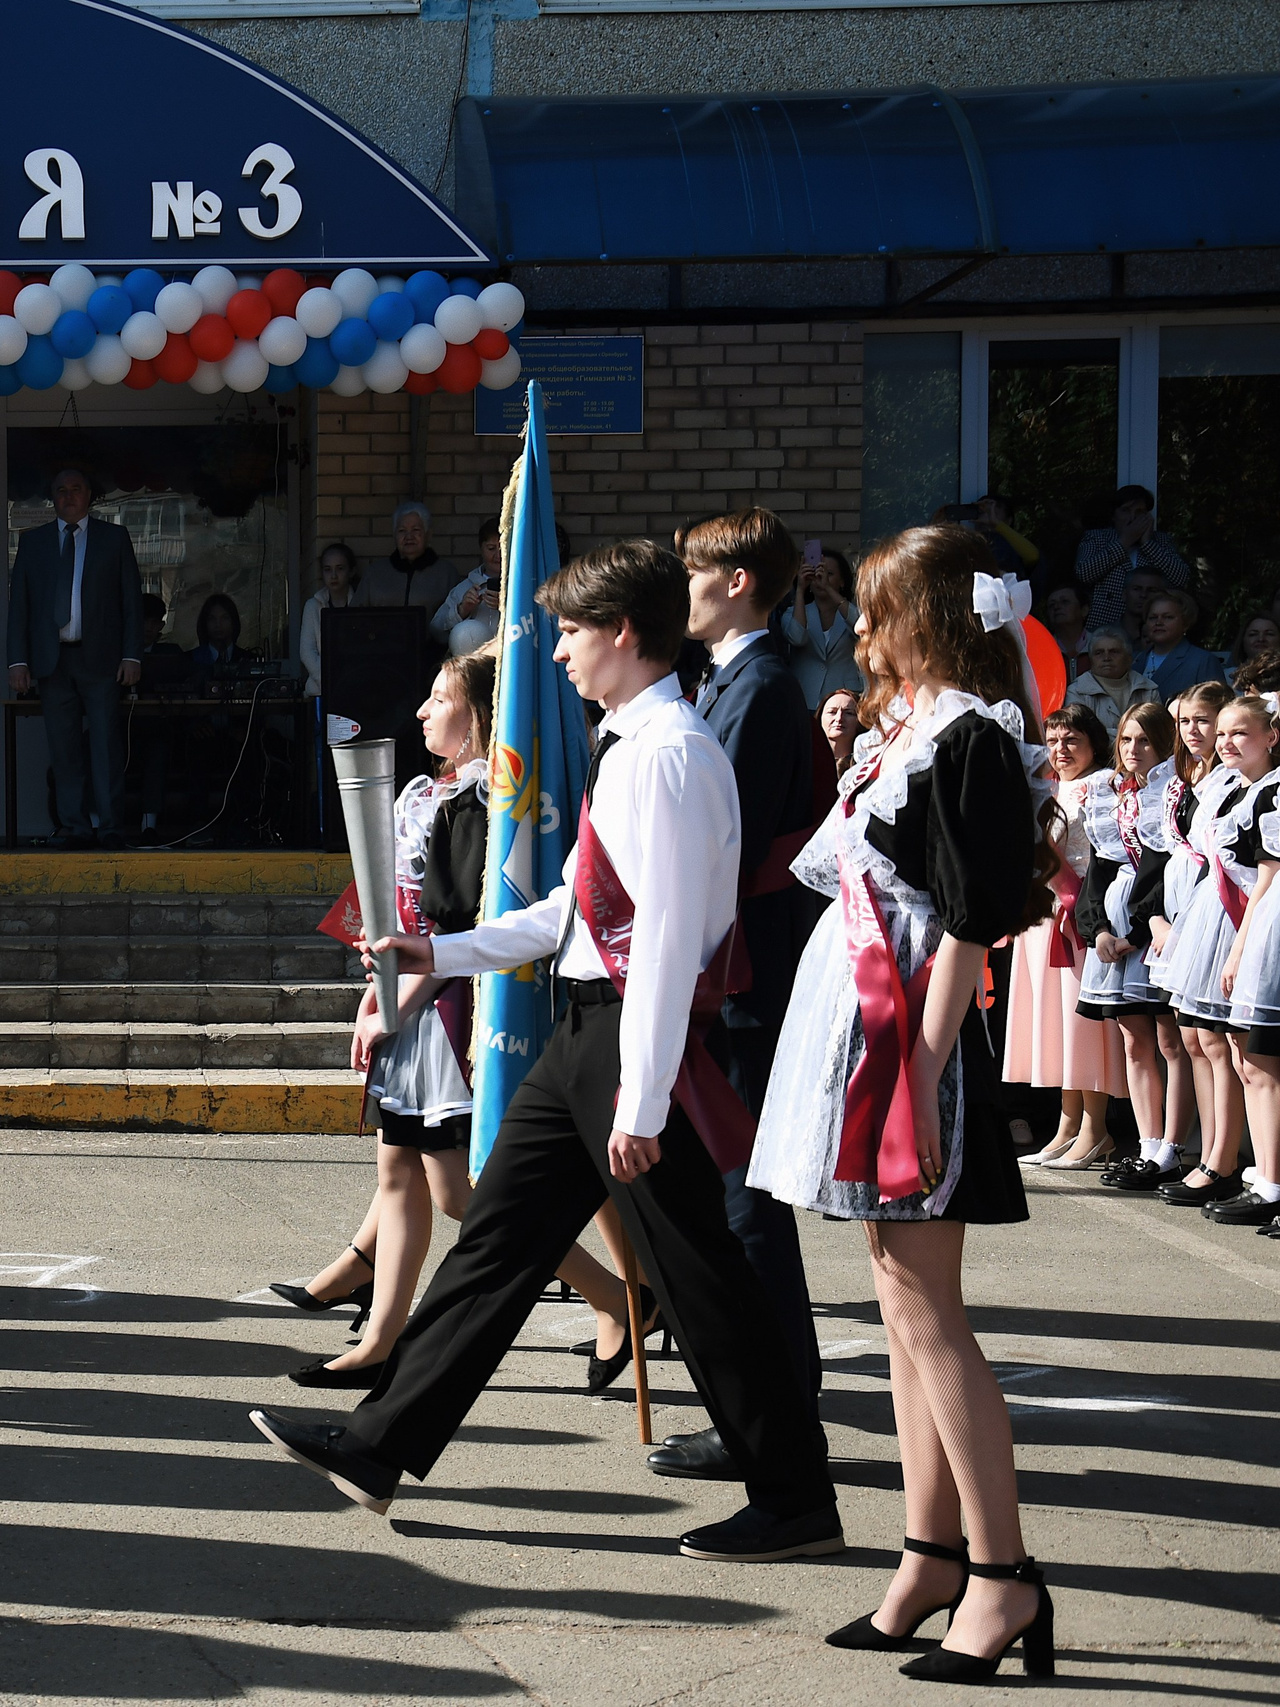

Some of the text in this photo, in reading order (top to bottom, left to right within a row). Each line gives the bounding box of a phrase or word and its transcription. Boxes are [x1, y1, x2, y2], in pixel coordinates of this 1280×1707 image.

[151, 181, 222, 239] №
[238, 142, 302, 240] 3
[548, 364, 633, 373] общеобразовательное
